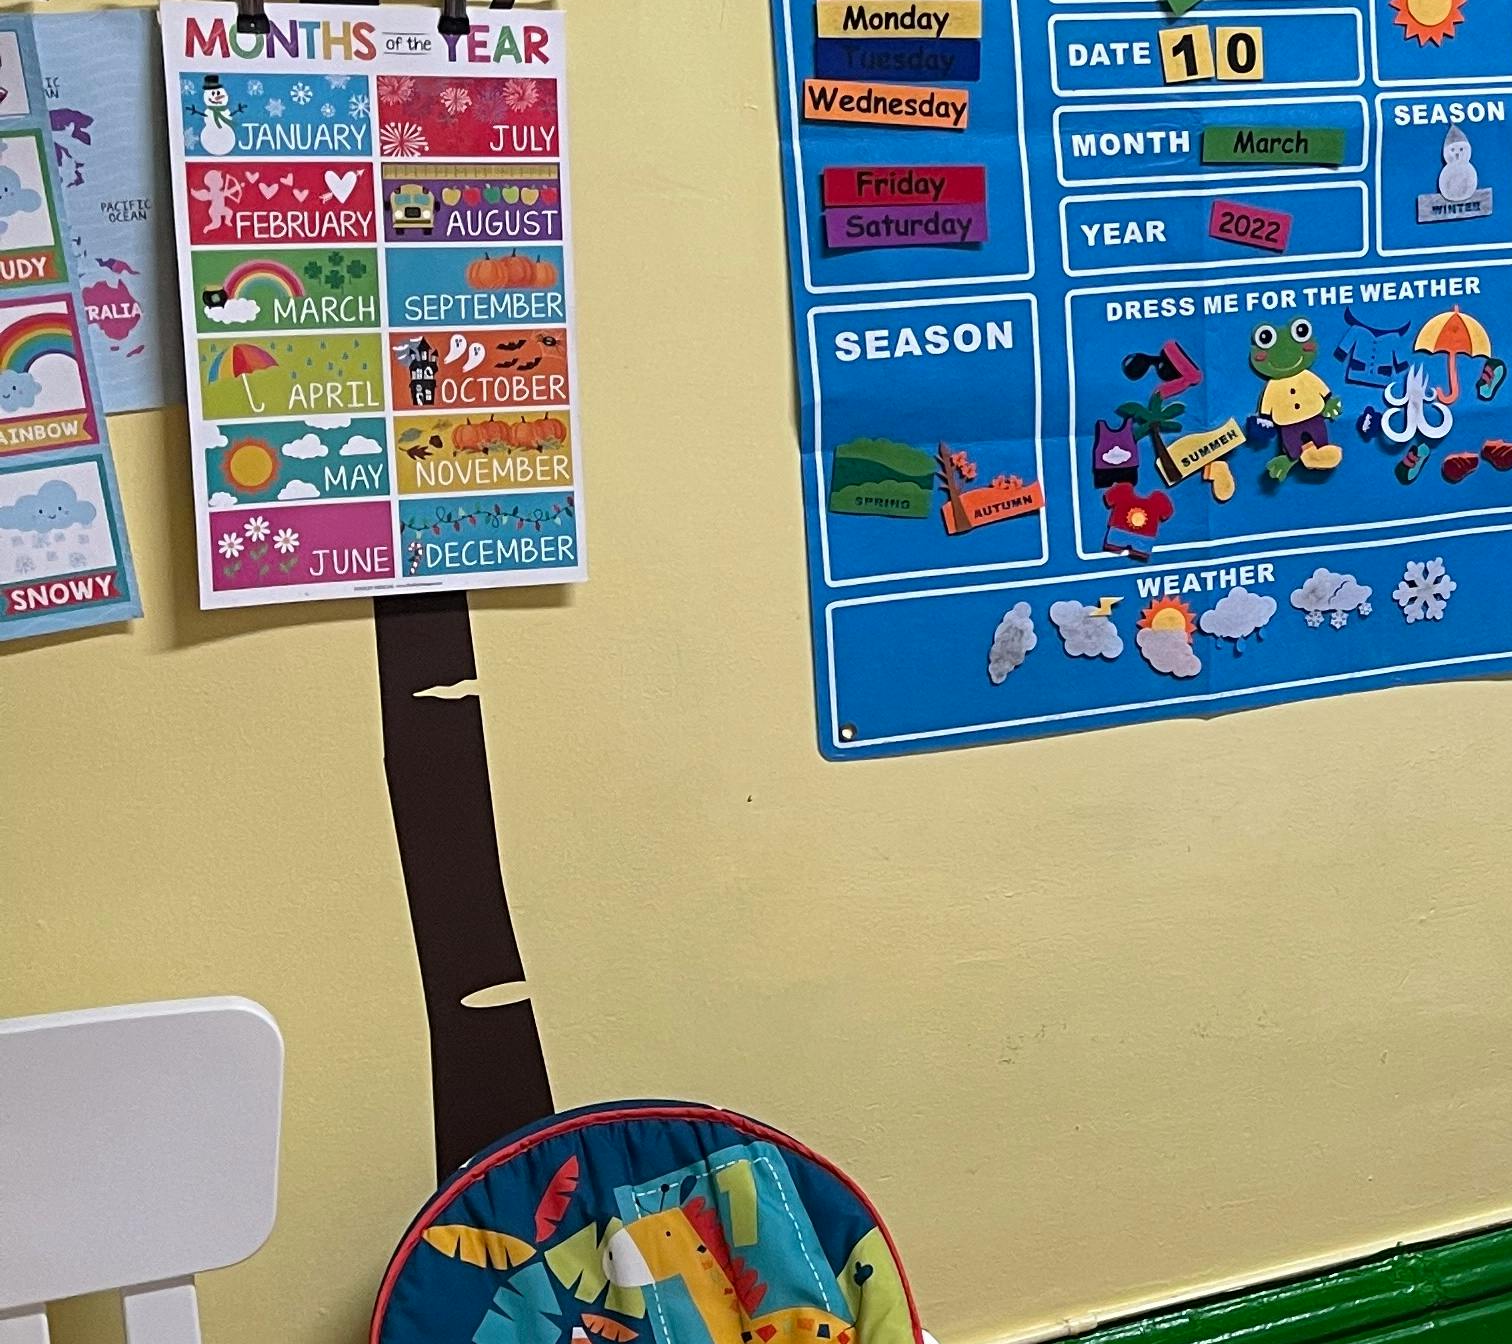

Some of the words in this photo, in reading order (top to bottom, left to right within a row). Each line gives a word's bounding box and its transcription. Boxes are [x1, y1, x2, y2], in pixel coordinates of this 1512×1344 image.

[842, 6, 949, 39] Monday
[185, 17, 376, 60] MONTHS
[385, 37, 404, 51] of
[408, 37, 432, 51] the
[441, 25, 550, 64] YEAR
[1068, 42, 1151, 67] DATE
[843, 45, 955, 78] Tuesday
[807, 86, 968, 126] Wednesday
[1393, 100, 1506, 126] SEASON
[238, 122, 367, 151] JANUARY
[489, 124, 555, 151] JULY
[1071, 131, 1190, 157] MONTH
[1233, 131, 1309, 155] March
[856, 171, 946, 202] Friday
[100, 199, 152, 212] PACIFIC
[109, 211, 147, 222] OCEAN
[1432, 201, 1480, 215] WINTER
[236, 211, 372, 240] FEBRUARY
[446, 209, 559, 237] AUGUST
[846, 212, 972, 240] Saturday
[1081, 220, 1167, 247] YEAR
[1218, 211, 1280, 243] 2022
[273, 296, 375, 324] MARCH
[404, 292, 563, 322] SEPTEMBER
[1106, 296, 1195, 322] DRESS
[1203, 293, 1239, 316] ME
[1246, 290, 1297, 312] FOR
[1303, 285, 1354, 307] THE
[1359, 276, 1481, 304] WEATHER
[835, 320, 1013, 362] SEASON
[288, 380, 380, 410] APRIL
[440, 376, 566, 404] OCTOBER
[1180, 429, 1240, 468] SUMMER
[324, 463, 384, 491] MAY
[415, 454, 570, 488] NOVEMBER
[854, 496, 910, 510] SPRING
[974, 494, 1033, 519] AUTUMN
[309, 546, 390, 576] JUNE
[426, 535, 574, 568] DECEMBER
[11, 574, 112, 611] SNOWY
[1136, 562, 1277, 597] WEATHER
